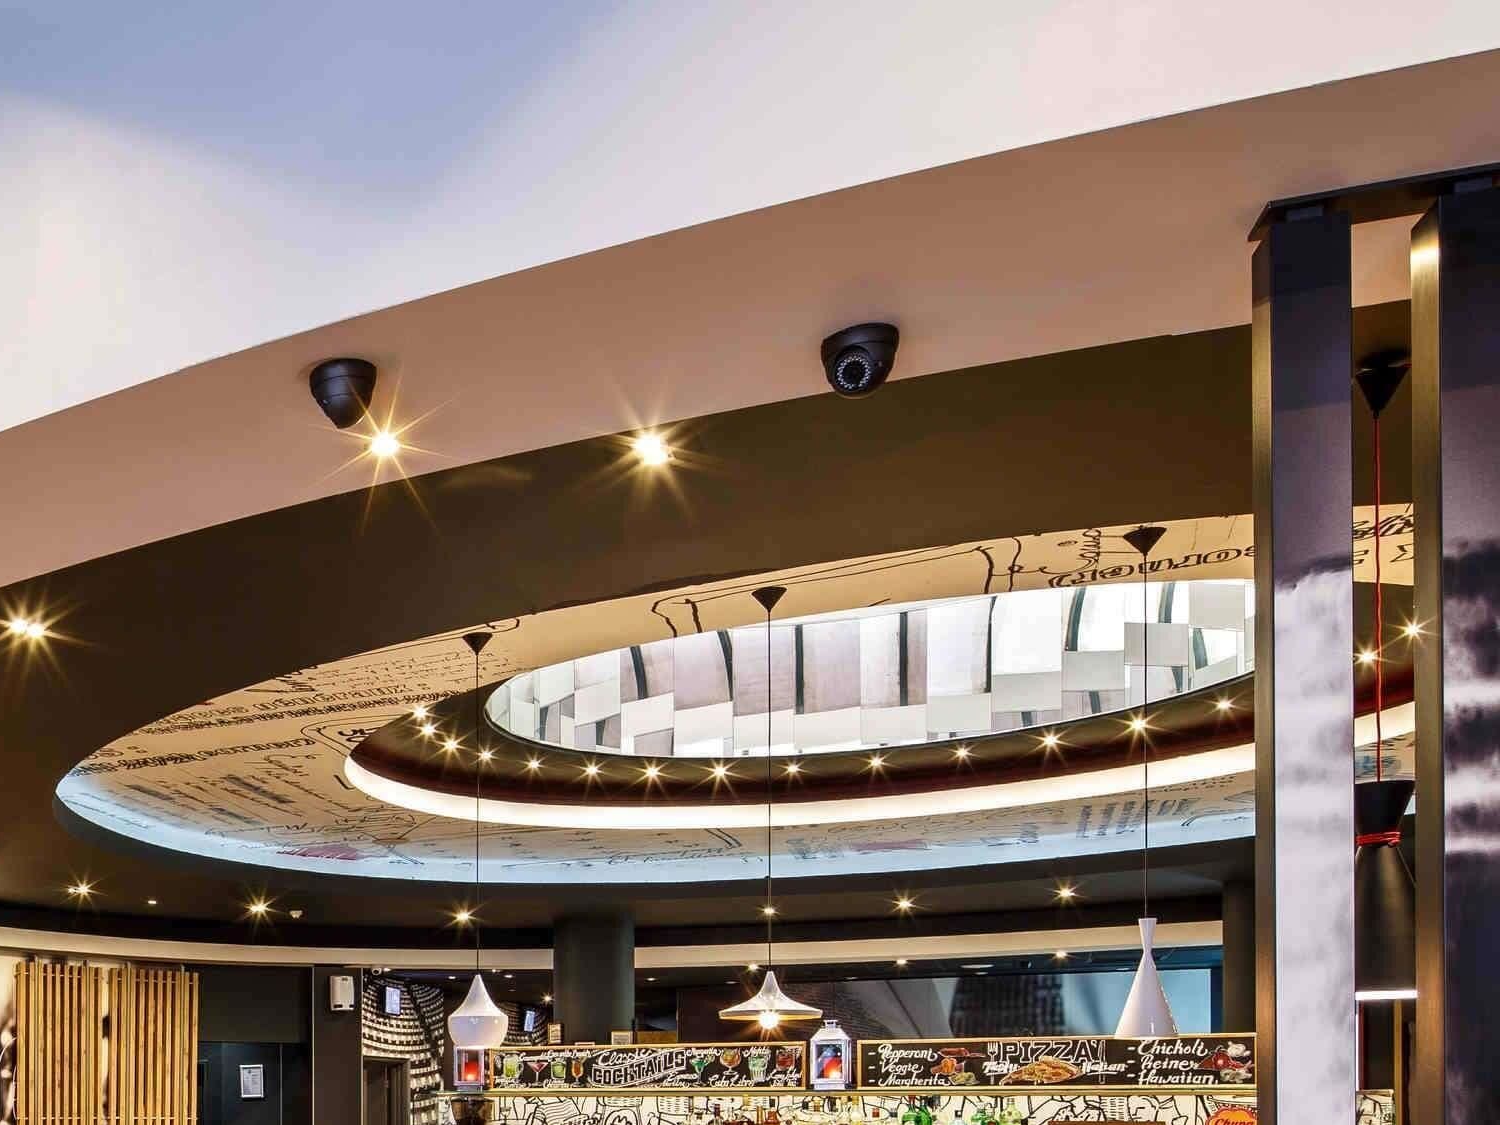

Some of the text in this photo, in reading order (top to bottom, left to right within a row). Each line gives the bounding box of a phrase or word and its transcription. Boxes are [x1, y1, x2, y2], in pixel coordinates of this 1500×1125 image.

[878, 1043, 938, 1063] Pepperoni
[1000, 1039, 1094, 1064] PIZZA
[591, 1049, 687, 1086] COCKTAILS
[879, 1060, 924, 1075] Veggie
[878, 1073, 950, 1087] Margherita
